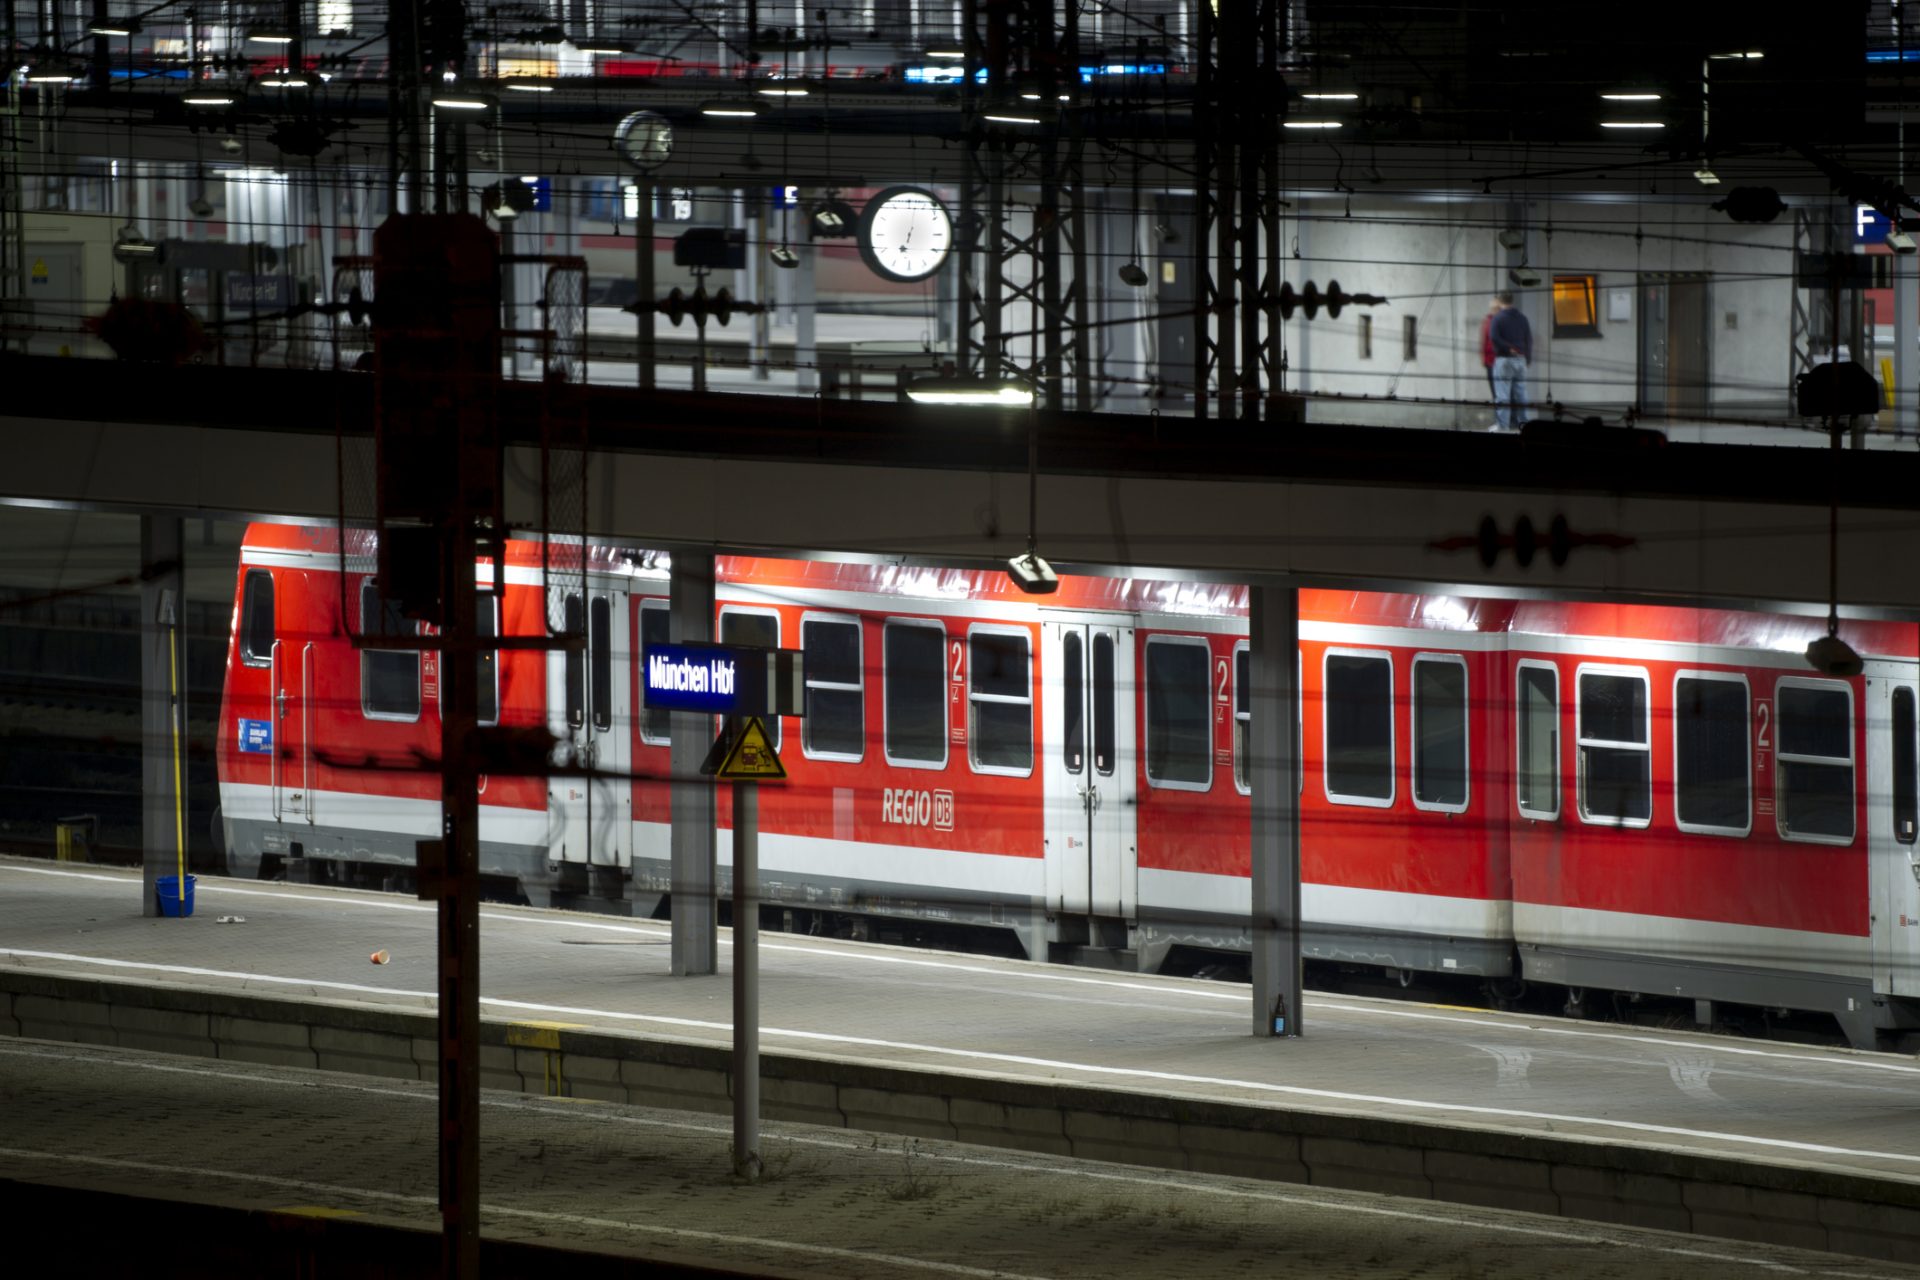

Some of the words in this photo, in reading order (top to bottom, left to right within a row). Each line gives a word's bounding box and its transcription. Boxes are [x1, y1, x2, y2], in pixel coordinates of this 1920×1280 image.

[1856, 203, 1876, 237] F
[649, 654, 709, 692] München
[710, 659, 735, 695] Hbf
[952, 641, 963, 682] 2
[1217, 660, 1229, 701] 2
[1757, 702, 1770, 747] 2
[881, 787, 932, 827] REGIO
[935, 793, 952, 827] DB
